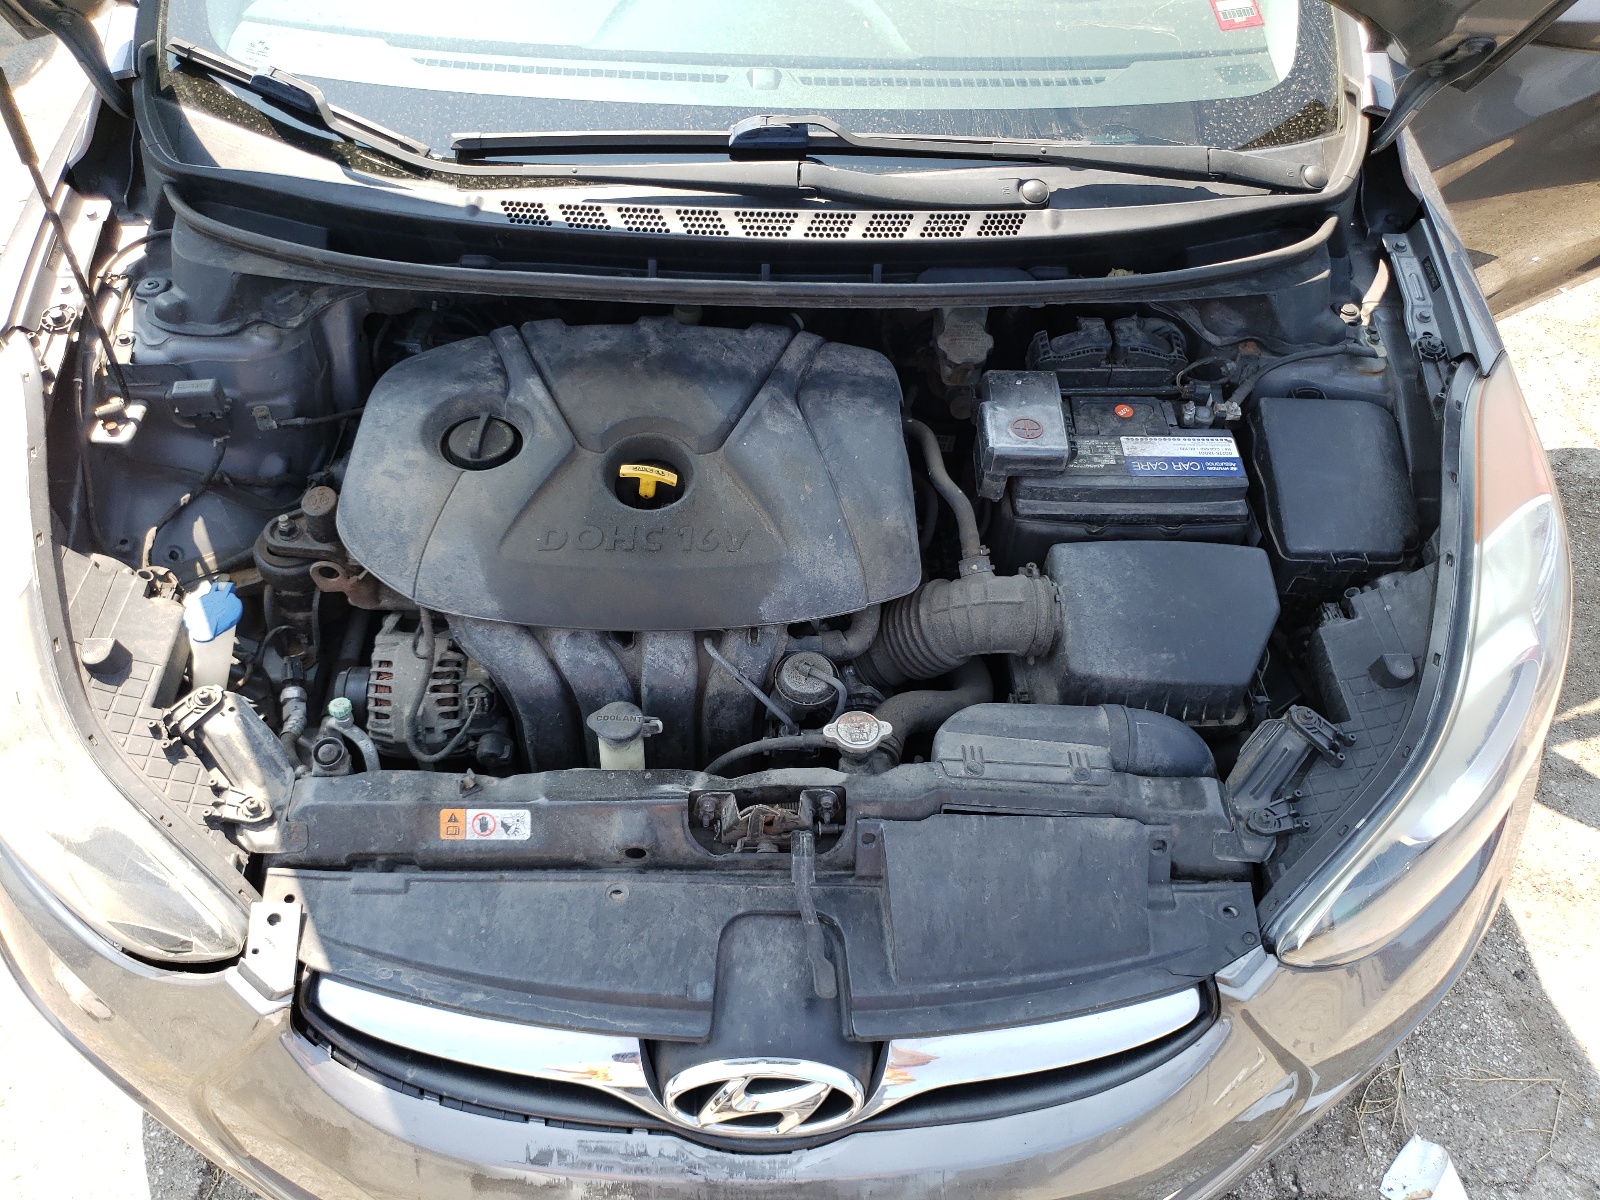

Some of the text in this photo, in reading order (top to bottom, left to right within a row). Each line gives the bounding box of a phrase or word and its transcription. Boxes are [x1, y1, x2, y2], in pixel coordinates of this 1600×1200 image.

[1131, 461, 1200, 471] CAR CARE
[538, 525, 752, 553] DOHC 16V
[596, 715, 643, 723] COOLANT
